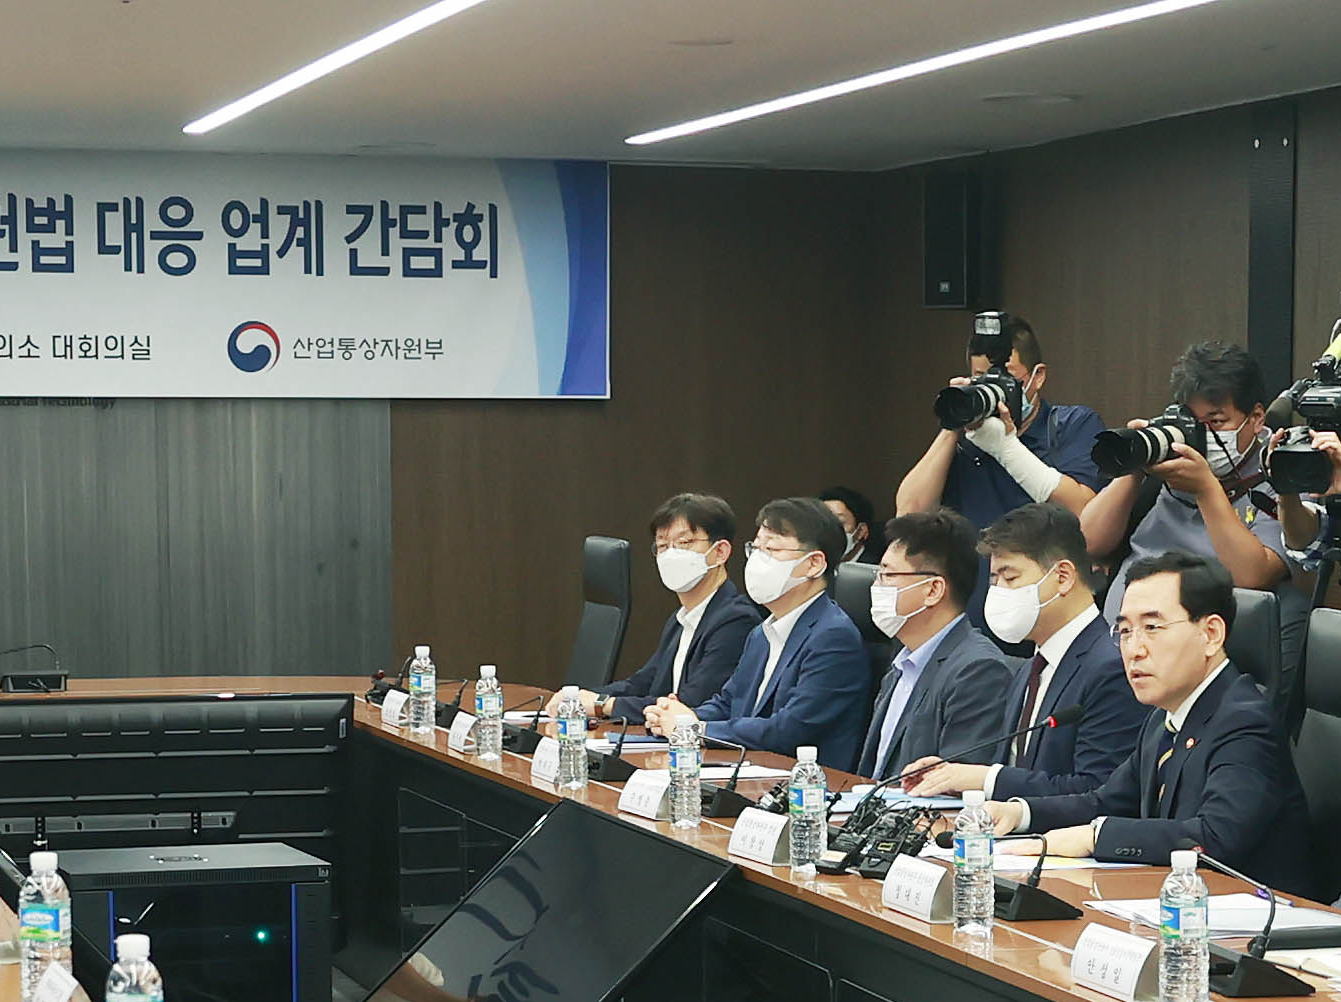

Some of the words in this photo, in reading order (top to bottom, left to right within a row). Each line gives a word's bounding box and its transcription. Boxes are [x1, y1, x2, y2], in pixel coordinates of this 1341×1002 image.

[96, 194, 204, 277] 대응
[221, 198, 325, 278] 업계
[343, 200, 499, 279] 간담회
[52, 334, 151, 361] 대회의실
[293, 336, 444, 361] 산업통상자원부
